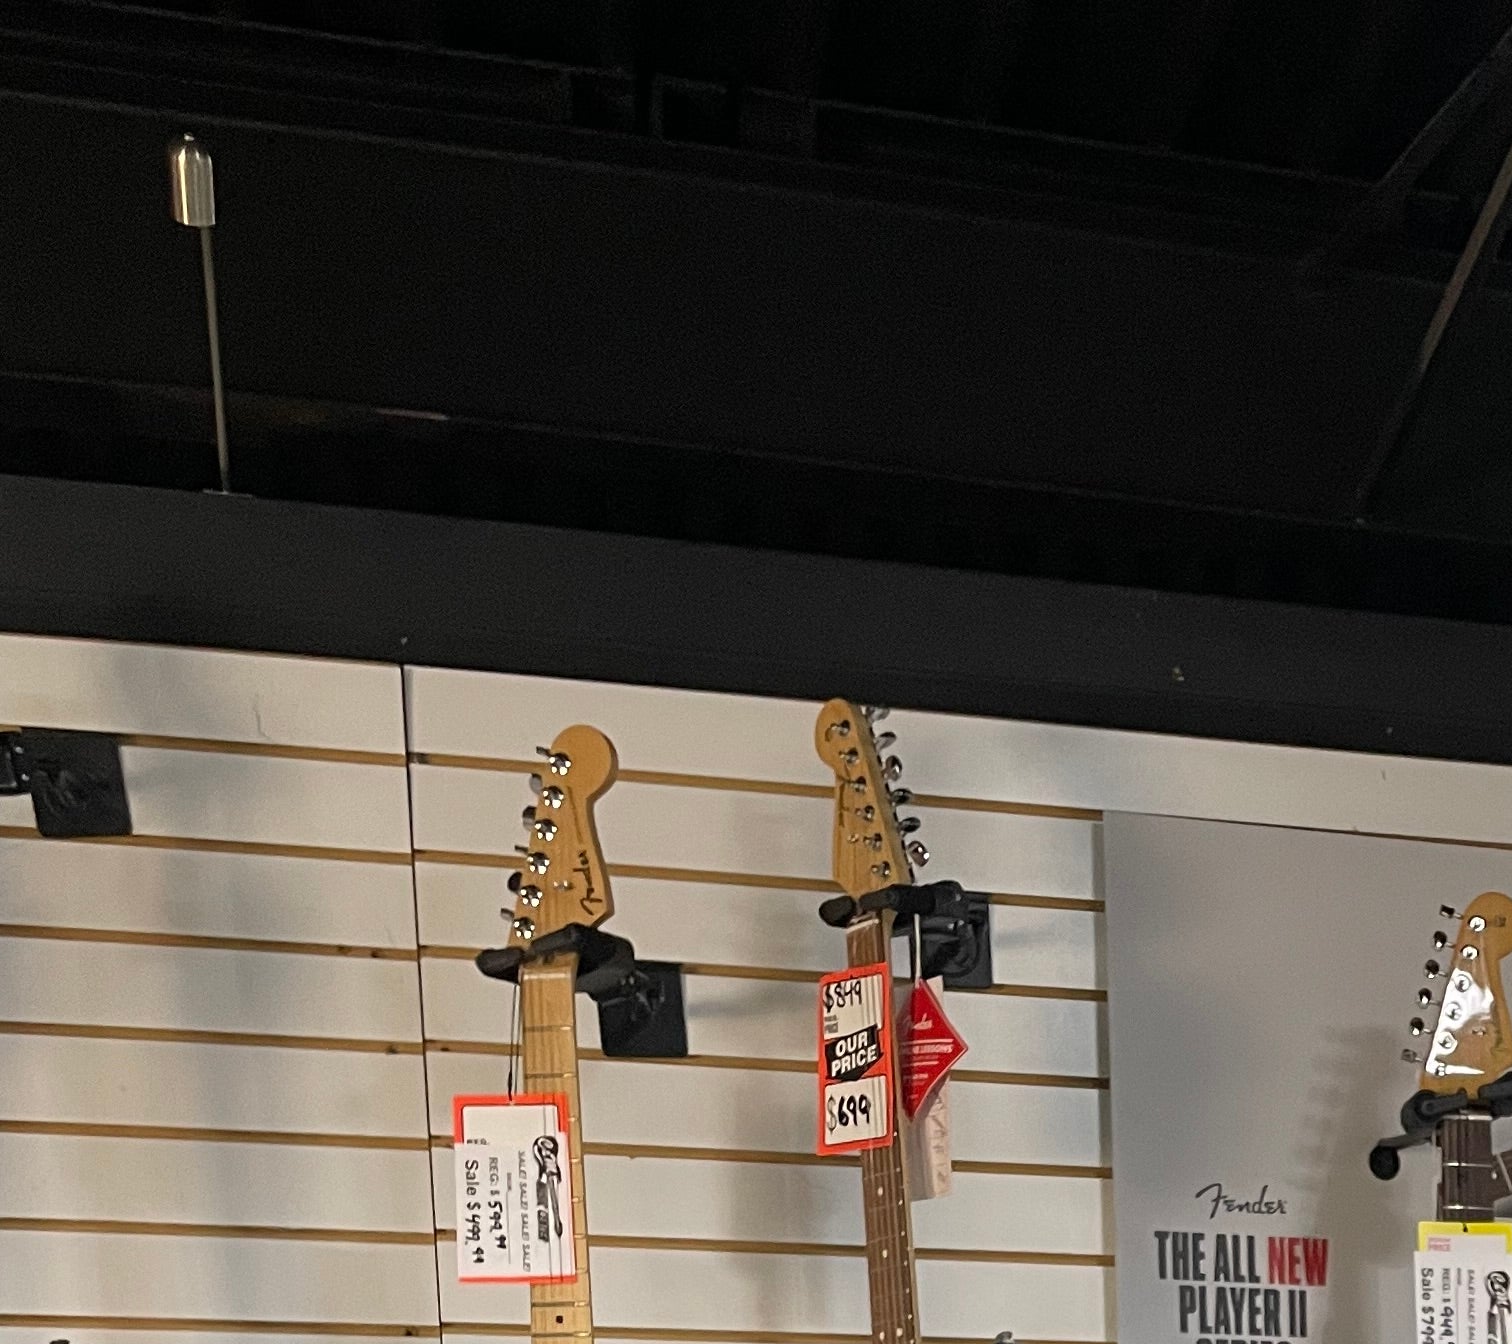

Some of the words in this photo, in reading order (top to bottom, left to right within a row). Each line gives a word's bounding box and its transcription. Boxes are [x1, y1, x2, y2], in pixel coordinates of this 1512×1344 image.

[824, 980, 862, 1013] $849
[831, 1044, 877, 1078] PRICE
[835, 1031, 868, 1057] OUR
[465, 1160, 480, 1196] Sale
[489, 1157, 500, 1186] REG:
[1195, 1183, 1287, 1219] Fender
[1154, 1231, 1207, 1281] THE
[1214, 1233, 1261, 1283] ALL
[1268, 1236, 1329, 1286] NEW
[1421, 1268, 1434, 1300] Sale
[1179, 1285, 1281, 1337] PLAYER
[1289, 1289, 1308, 1338] II
